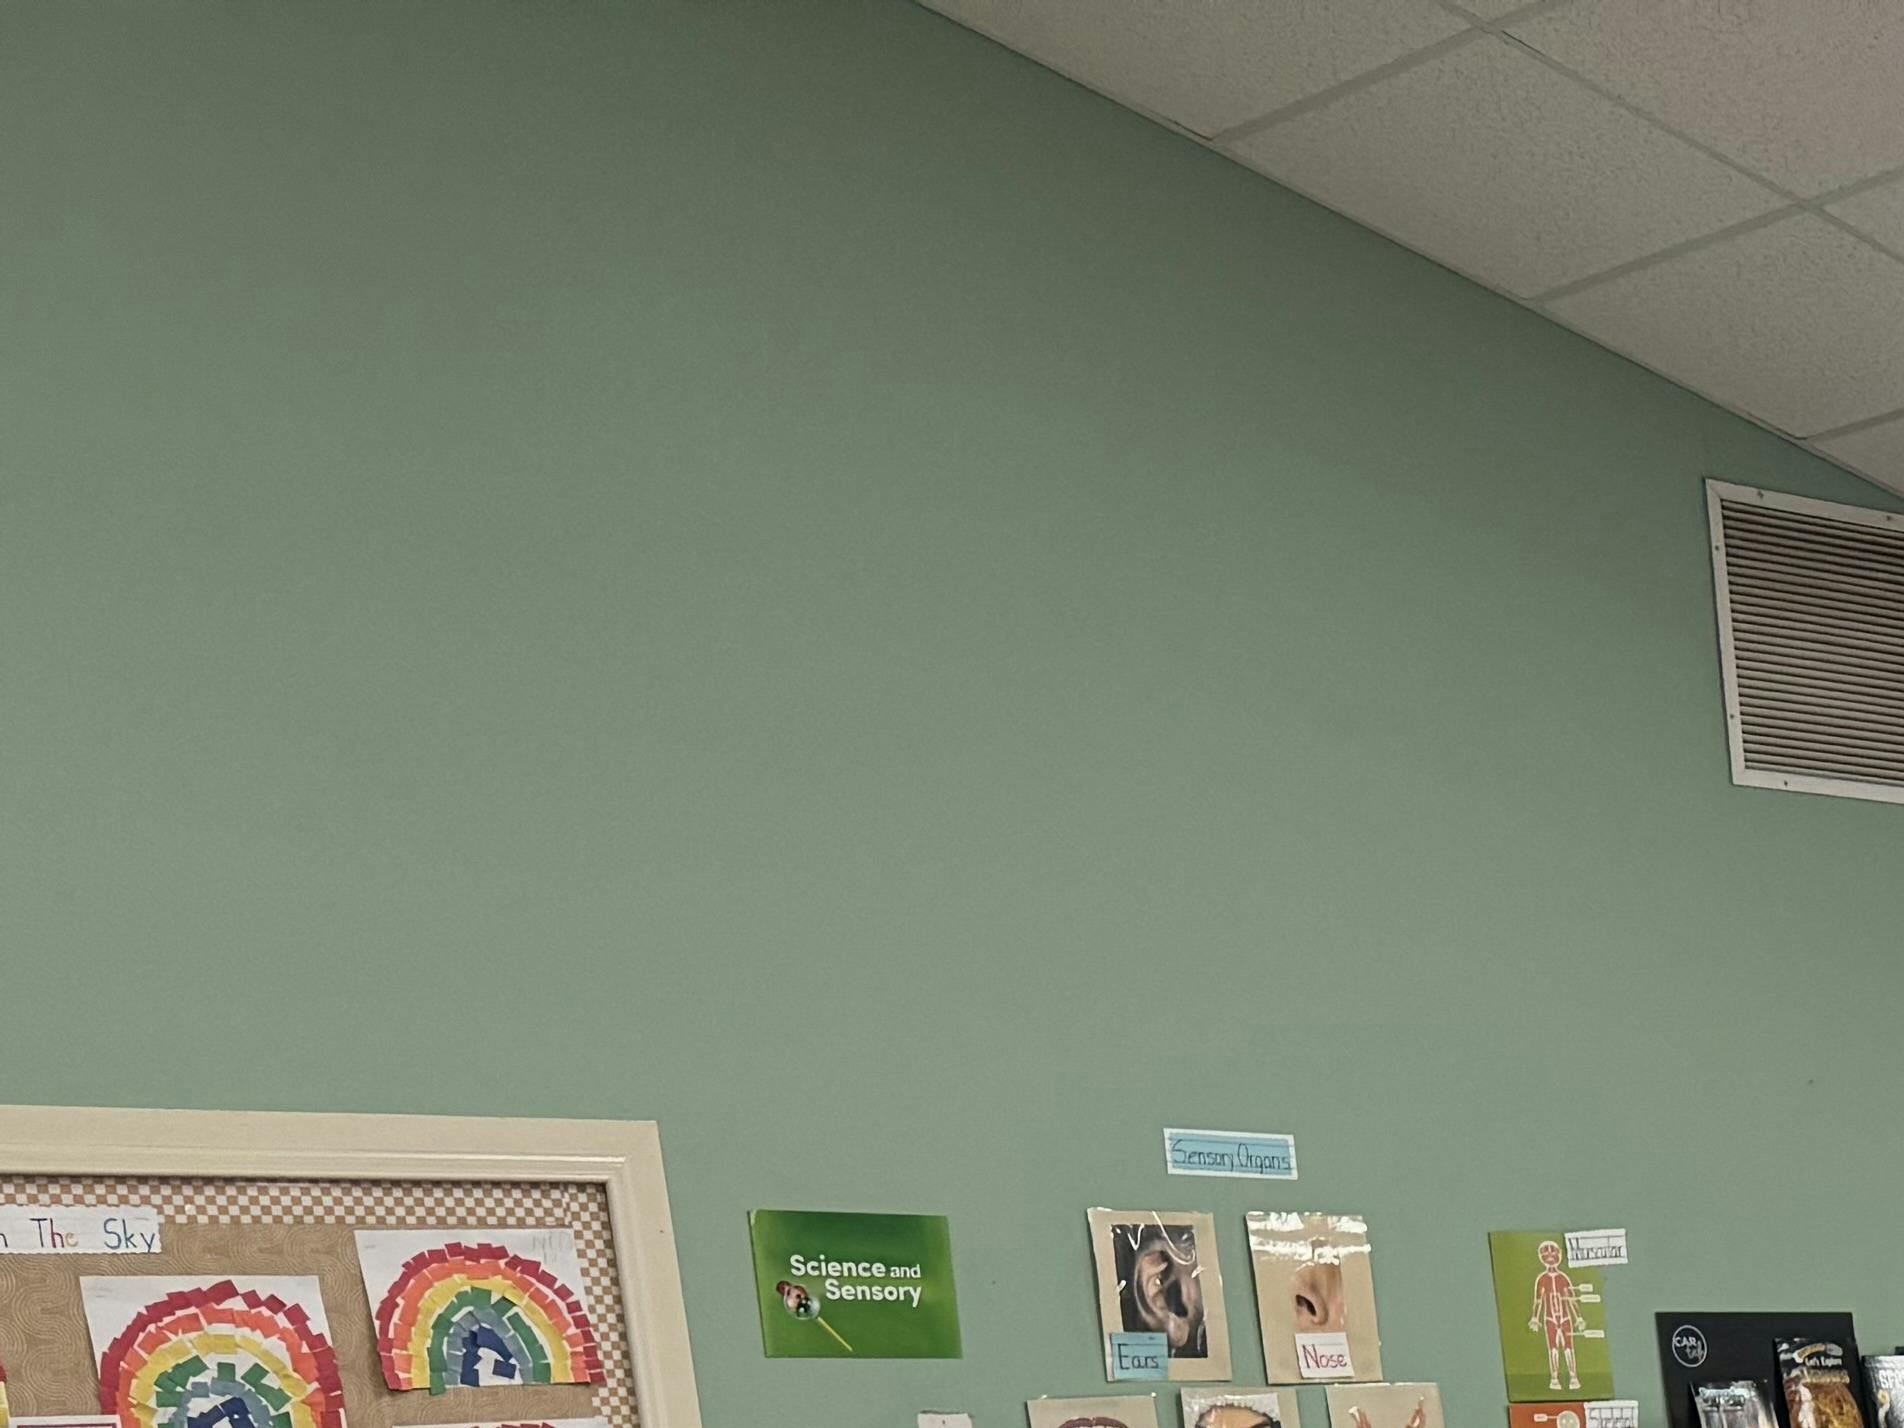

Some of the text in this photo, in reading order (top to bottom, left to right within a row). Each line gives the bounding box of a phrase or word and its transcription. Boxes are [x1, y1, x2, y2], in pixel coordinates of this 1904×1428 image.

[1170, 1138, 1293, 1175] Sensory Organs
[29, 1216, 156, 1254] The Sky
[789, 1253, 922, 1280] Science and
[824, 1277, 923, 1308] Sensory
[1116, 1342, 1160, 1371] Ears
[1301, 1341, 1348, 1371] Nose
